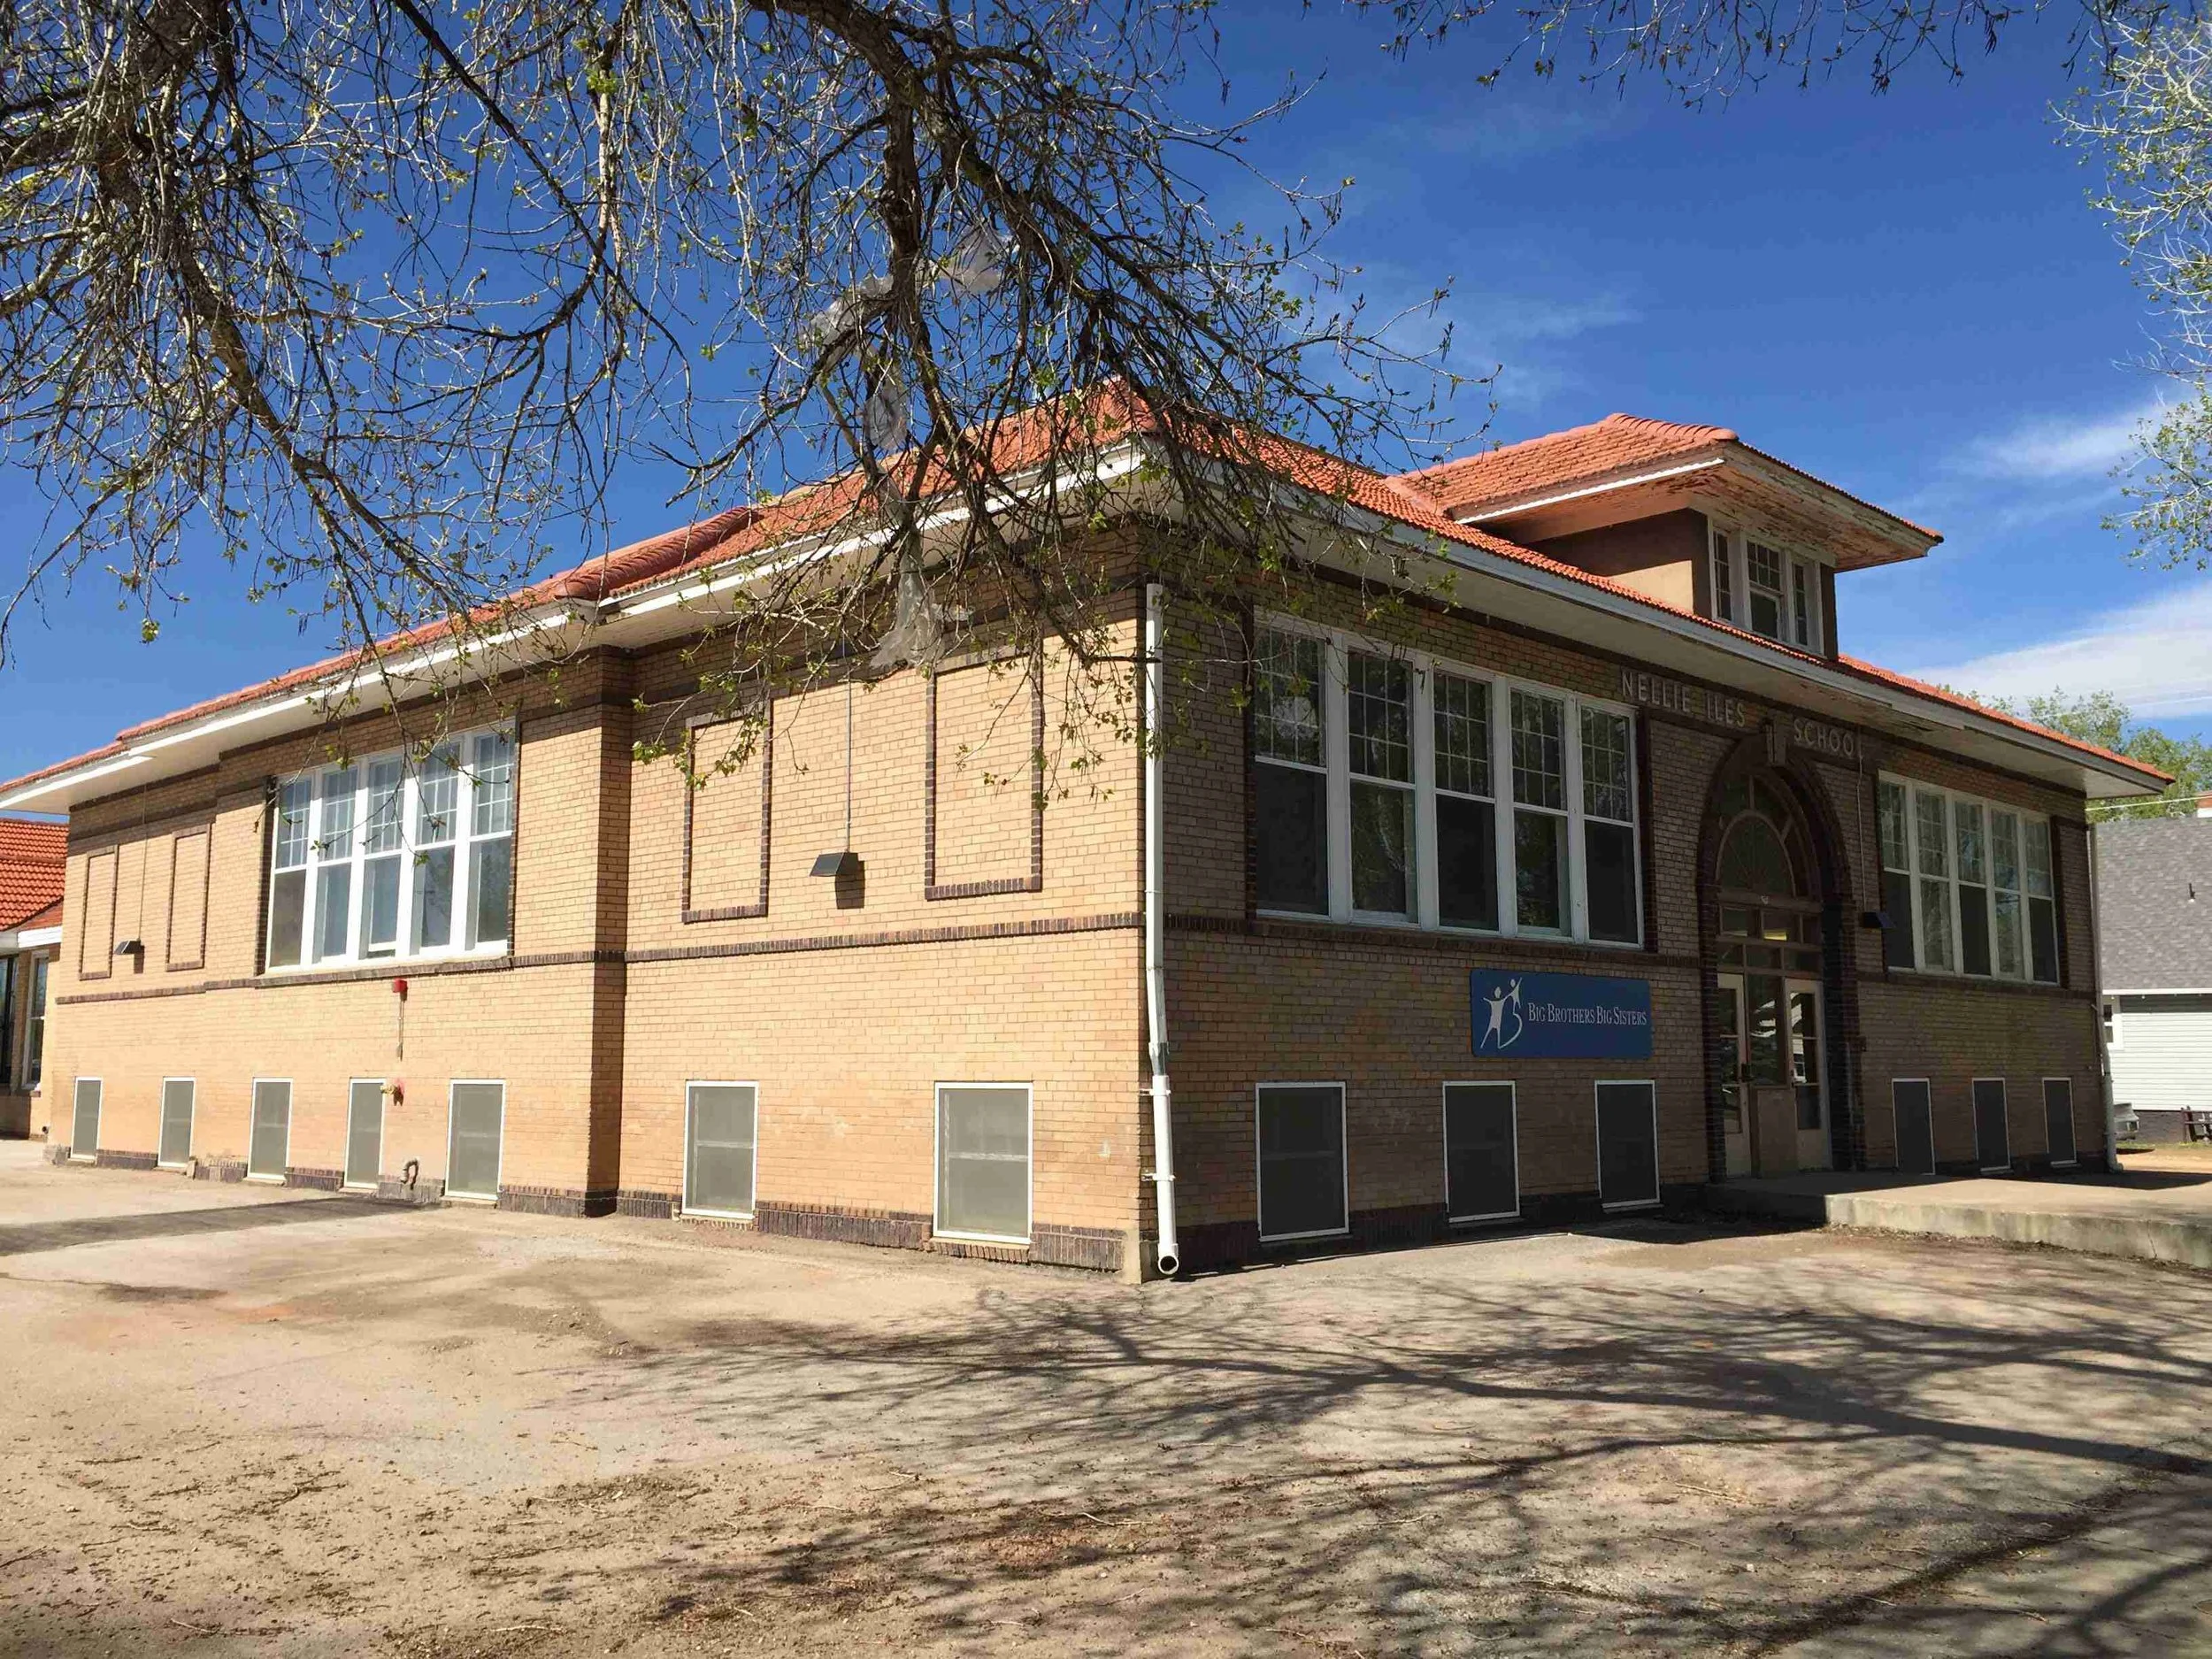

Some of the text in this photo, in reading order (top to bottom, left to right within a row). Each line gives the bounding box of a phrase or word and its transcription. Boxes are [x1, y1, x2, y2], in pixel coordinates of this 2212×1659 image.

[1622, 672, 1691, 712] NELLIE
[1707, 692, 1746, 727] ILES
[1548, 1003, 1595, 1024] BROTHERS
